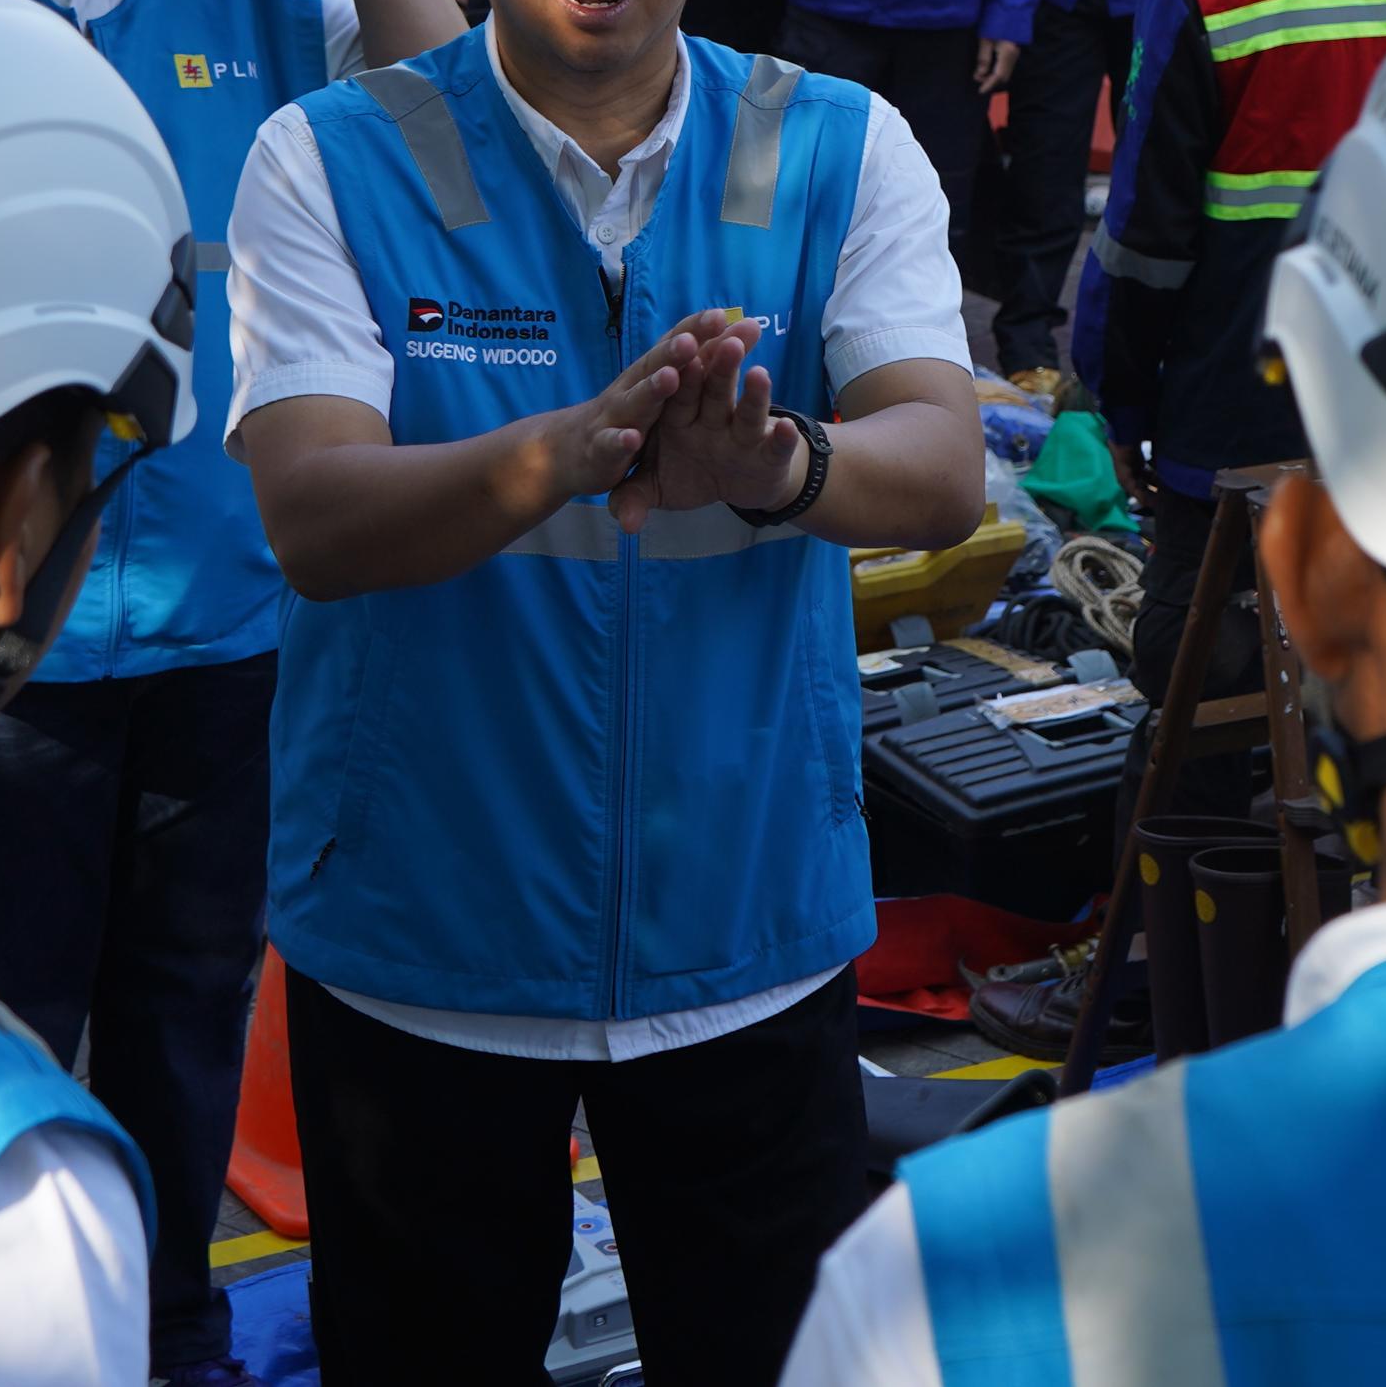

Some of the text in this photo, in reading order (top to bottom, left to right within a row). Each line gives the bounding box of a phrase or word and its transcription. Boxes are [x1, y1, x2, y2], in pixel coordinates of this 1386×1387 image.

[448, 301, 556, 323] Danantara
[448, 319, 549, 340] Indonesia
[406, 340, 557, 366] SUGENG WIDODO
